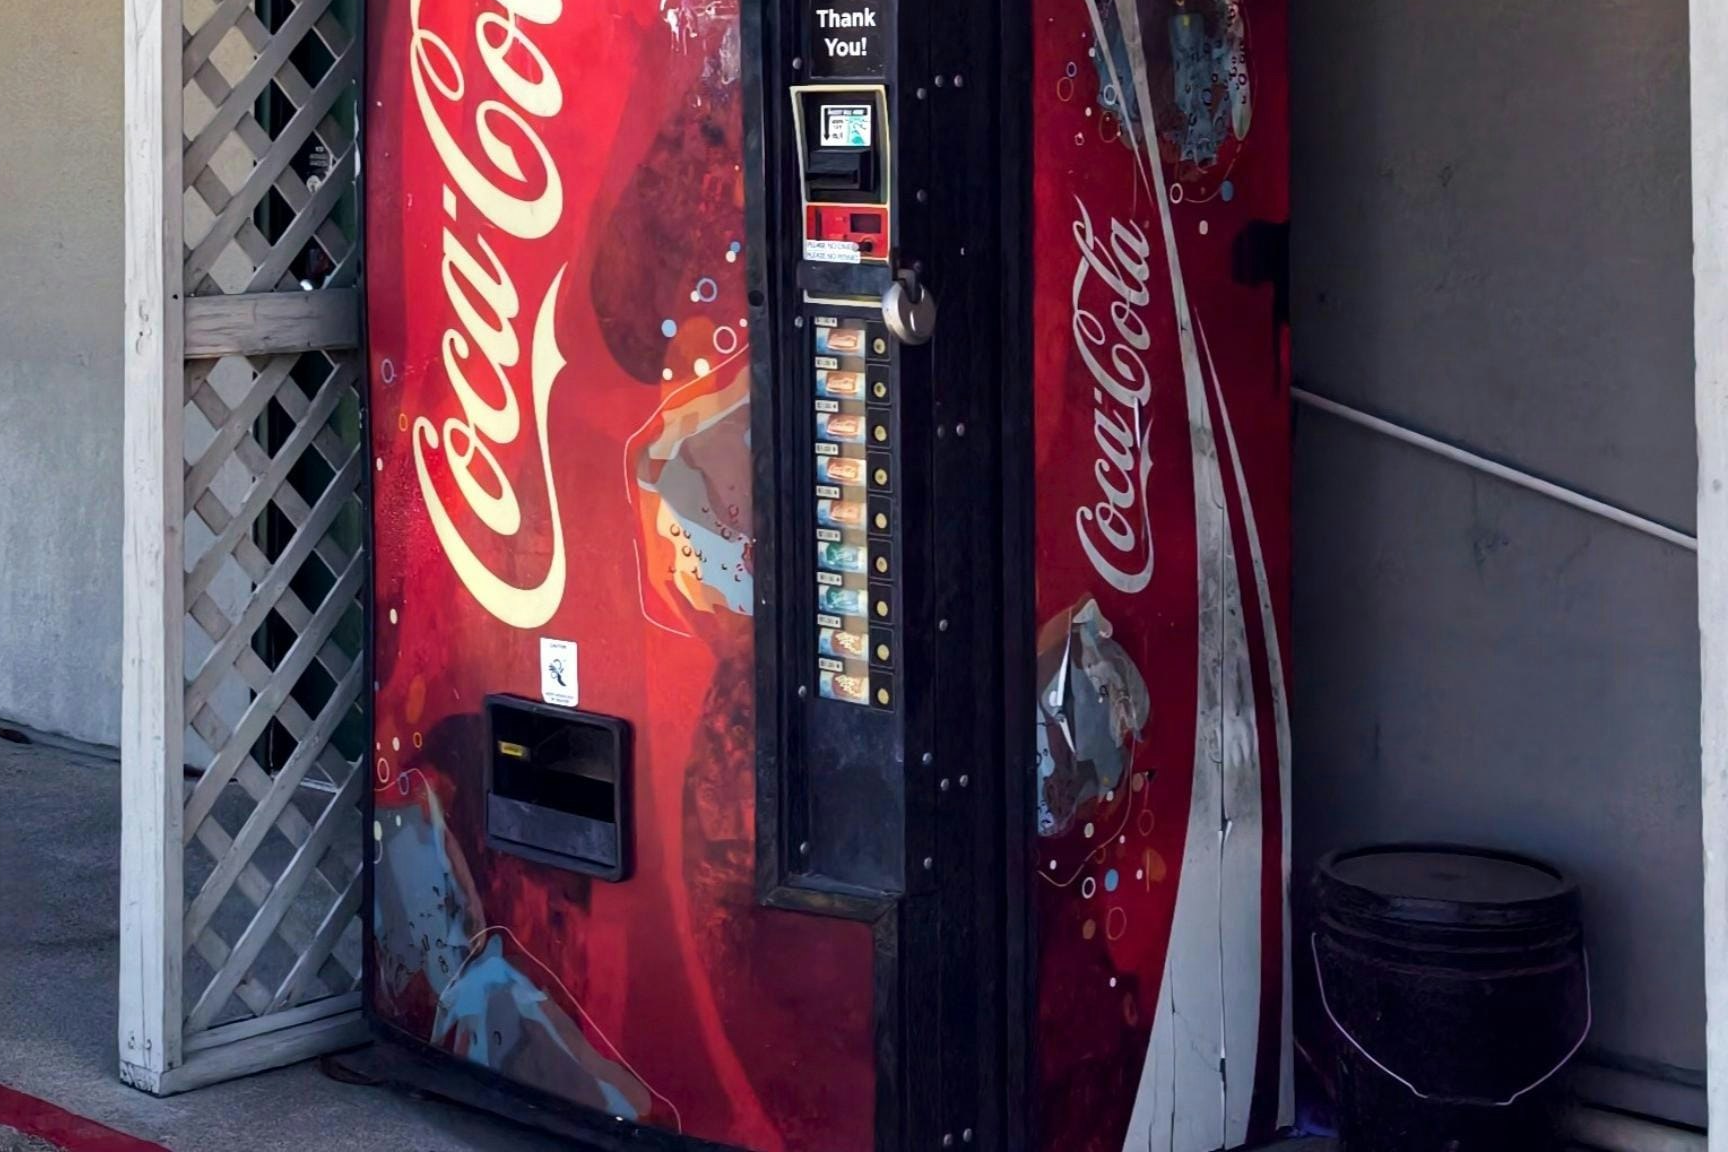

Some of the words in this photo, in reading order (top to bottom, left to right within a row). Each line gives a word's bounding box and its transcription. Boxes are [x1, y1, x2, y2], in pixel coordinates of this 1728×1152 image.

[815, 7, 876, 28] Thank
[823, 36, 868, 57] You!
[1072, 192, 1155, 594] Coca-Cola
